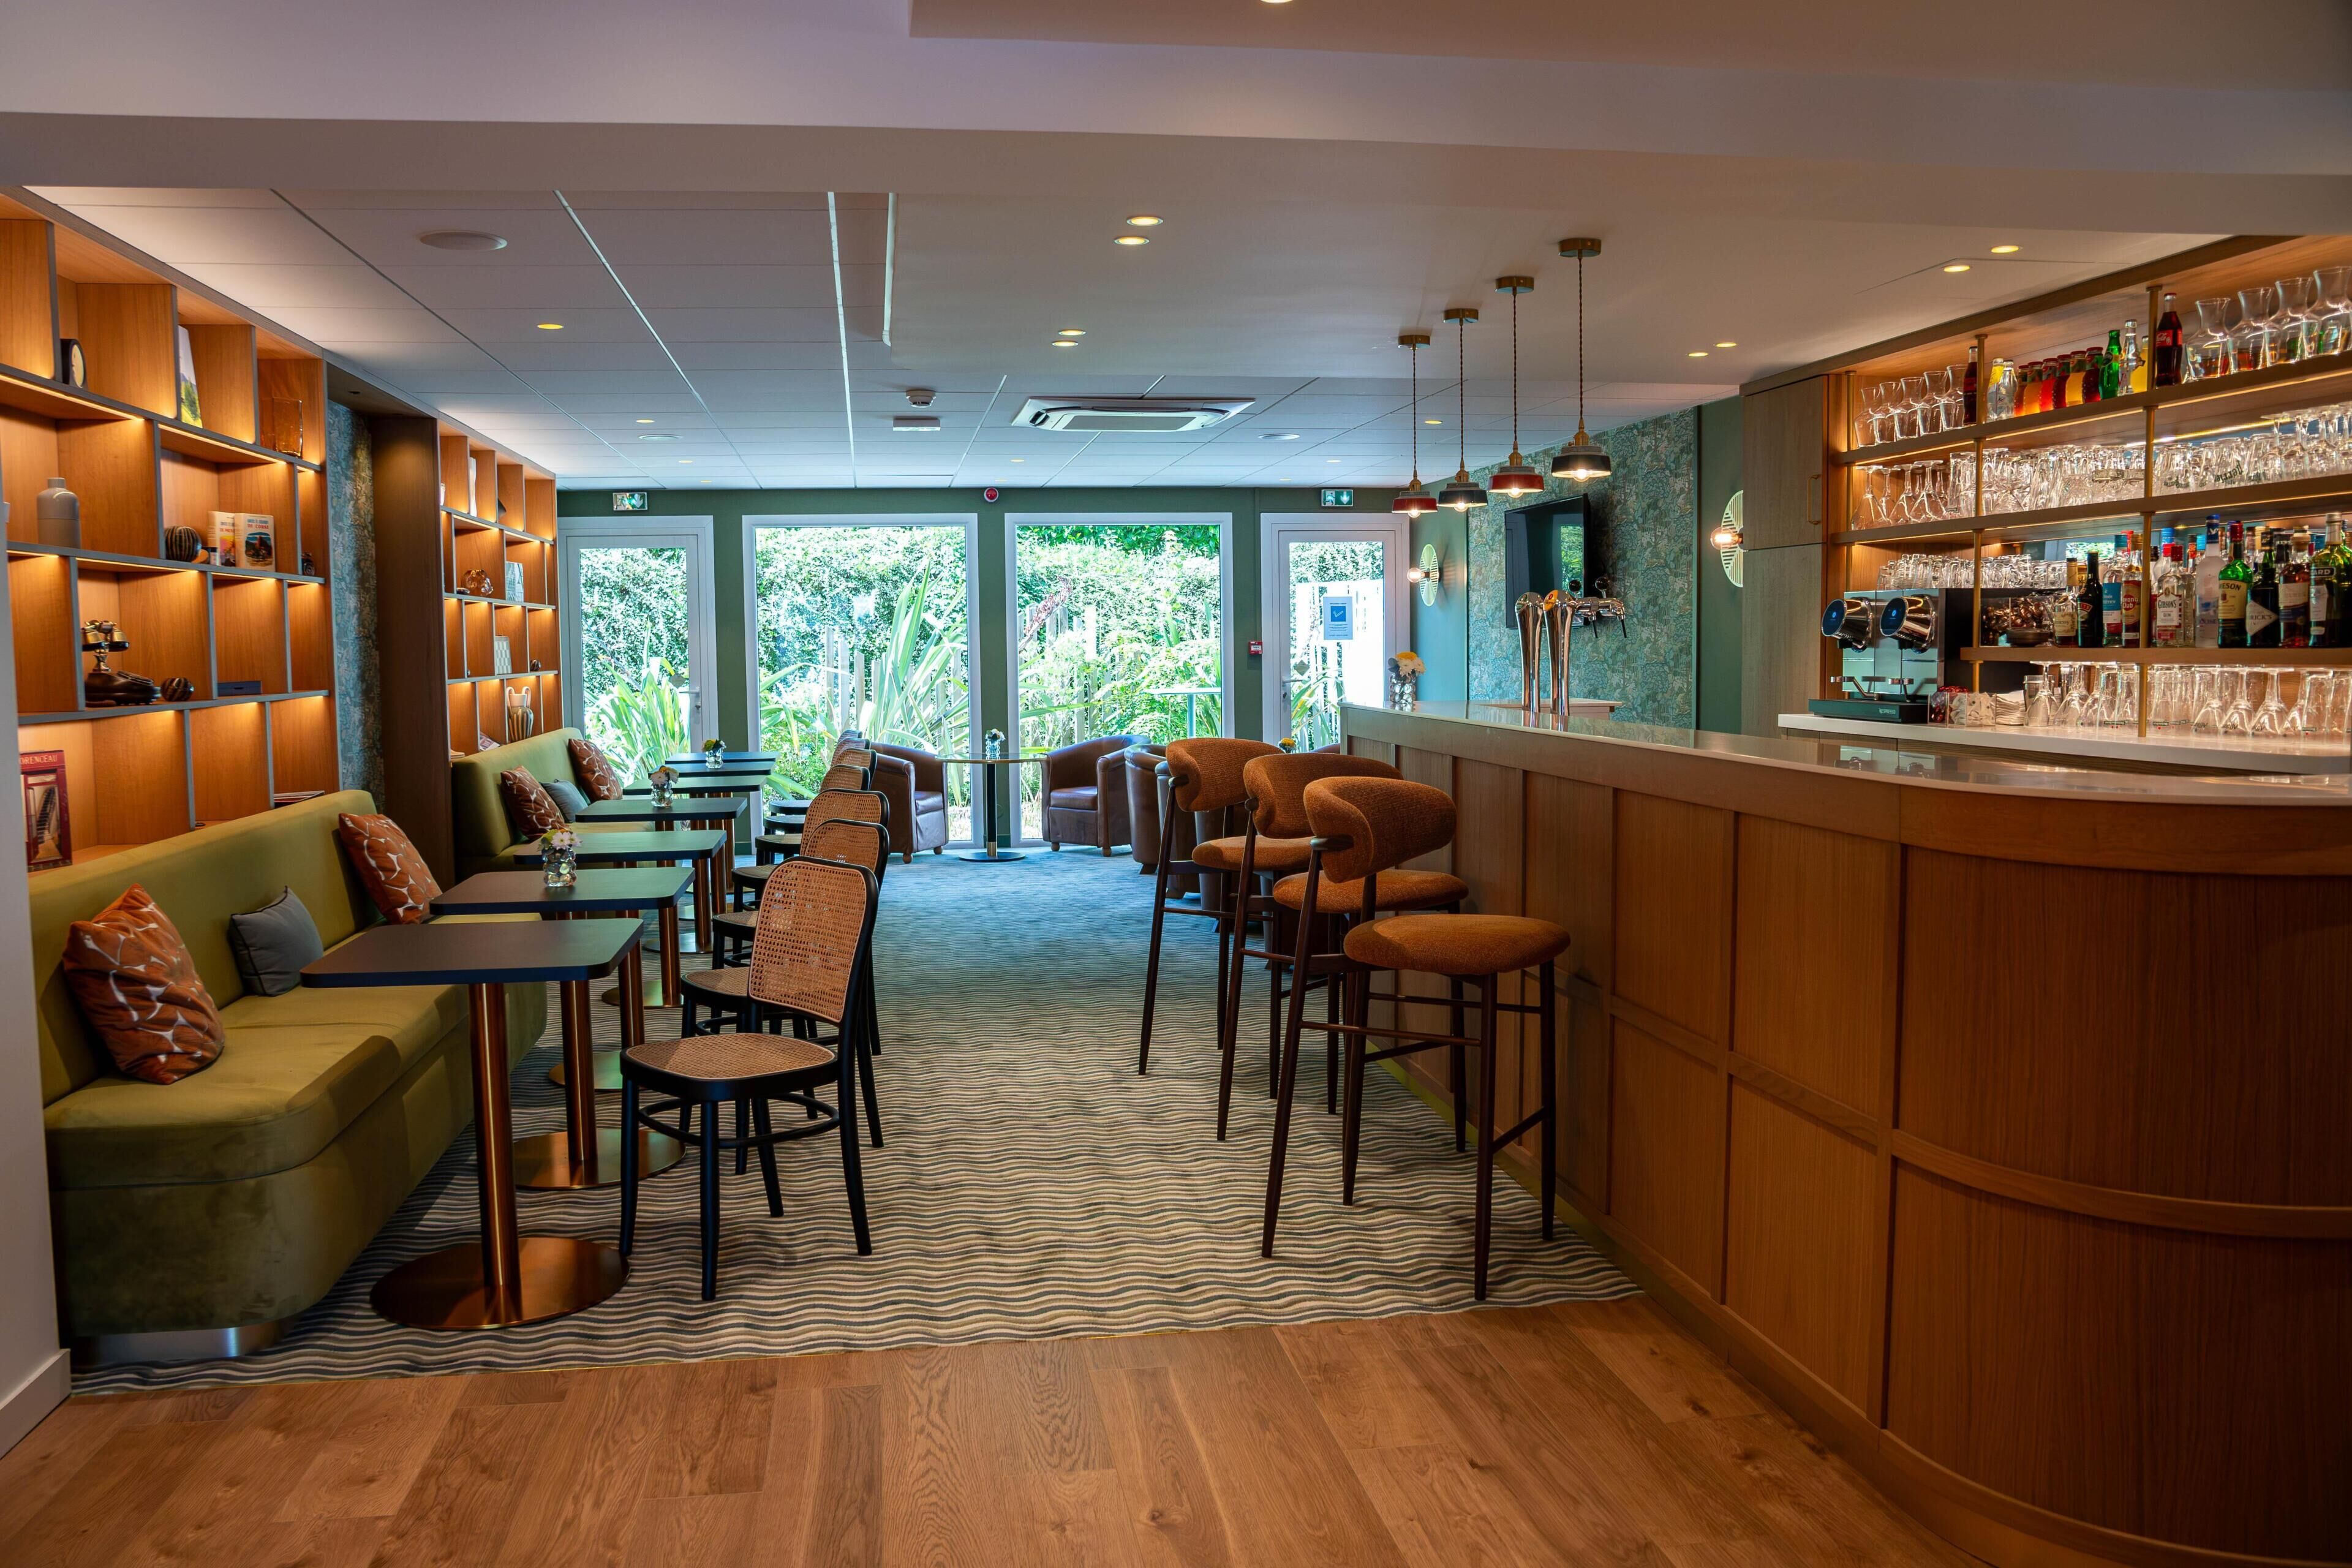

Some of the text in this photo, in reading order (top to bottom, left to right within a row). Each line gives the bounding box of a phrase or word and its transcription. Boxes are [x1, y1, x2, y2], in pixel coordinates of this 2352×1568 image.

[2214, 461, 2244, 483] Perrie
[2219, 582, 2242, 591] ESON
[20, 754, 57, 764] ORENCEAU
